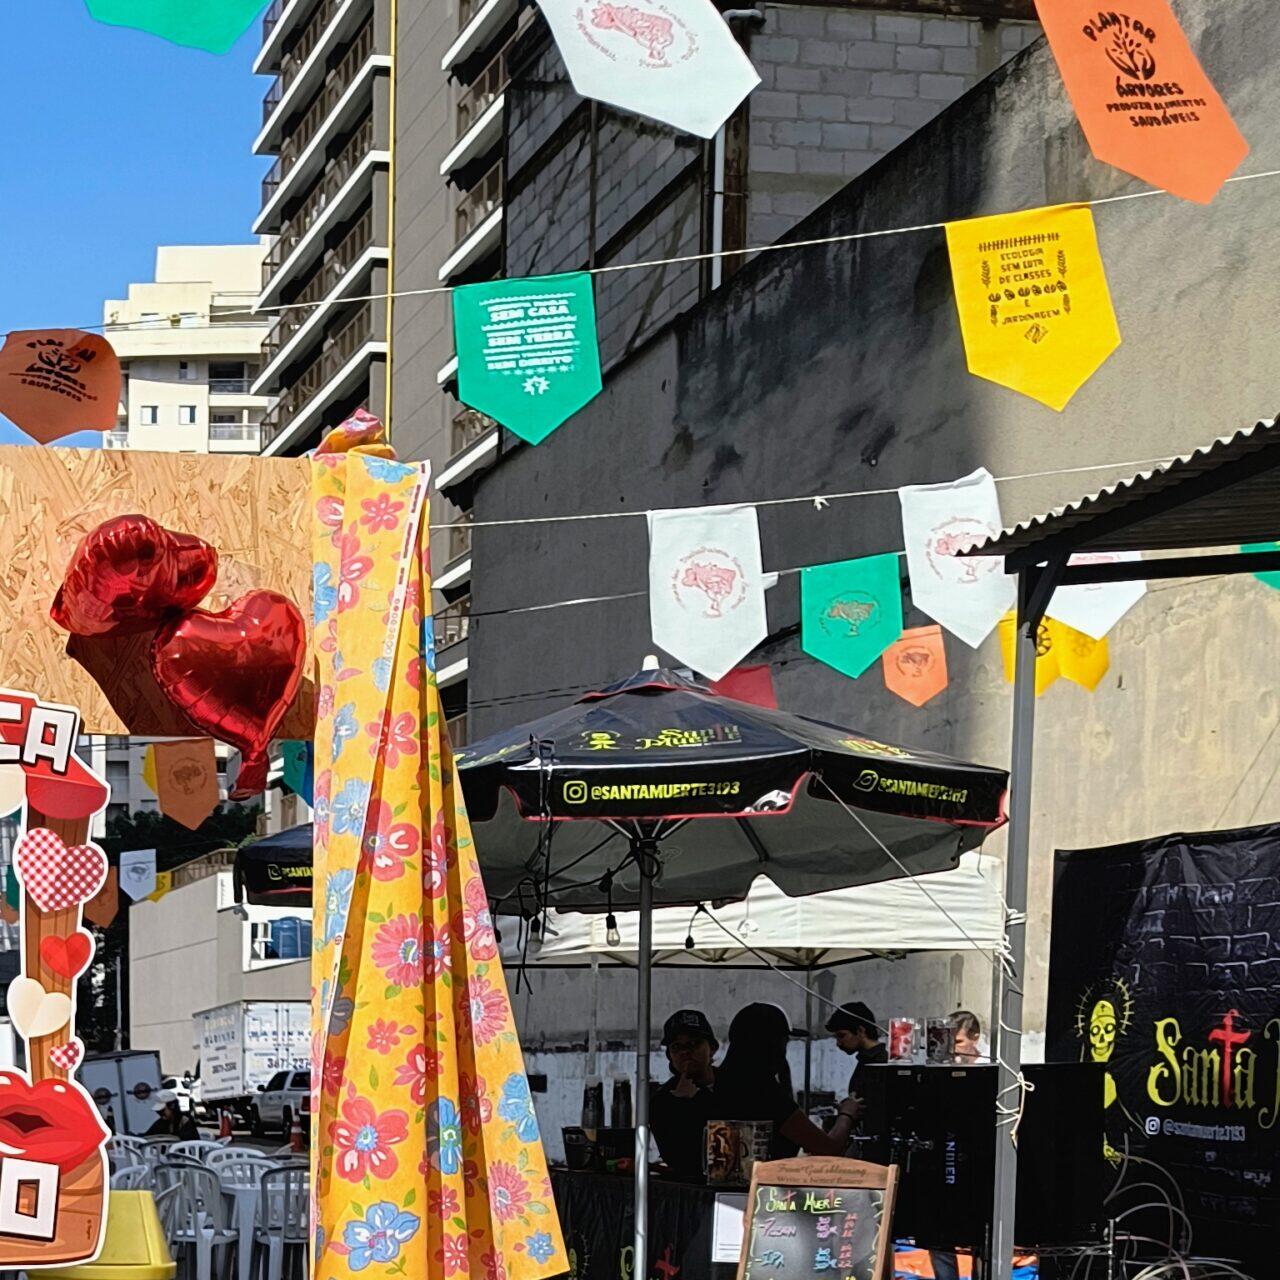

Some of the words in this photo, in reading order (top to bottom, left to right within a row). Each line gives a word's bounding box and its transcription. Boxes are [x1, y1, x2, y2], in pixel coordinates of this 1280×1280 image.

[1082, 11, 1157, 44] PLANTAR
[1116, 75, 1184, 97] ÁRVORES
[1129, 108, 1200, 127] SAUDÁVEIS
[999, 275, 1011, 284] DE
[527, 305, 570, 317] CASA
[591, 781, 740, 800] @SANTAMUERTE3193
[1147, 1008, 1257, 1109] Santa
